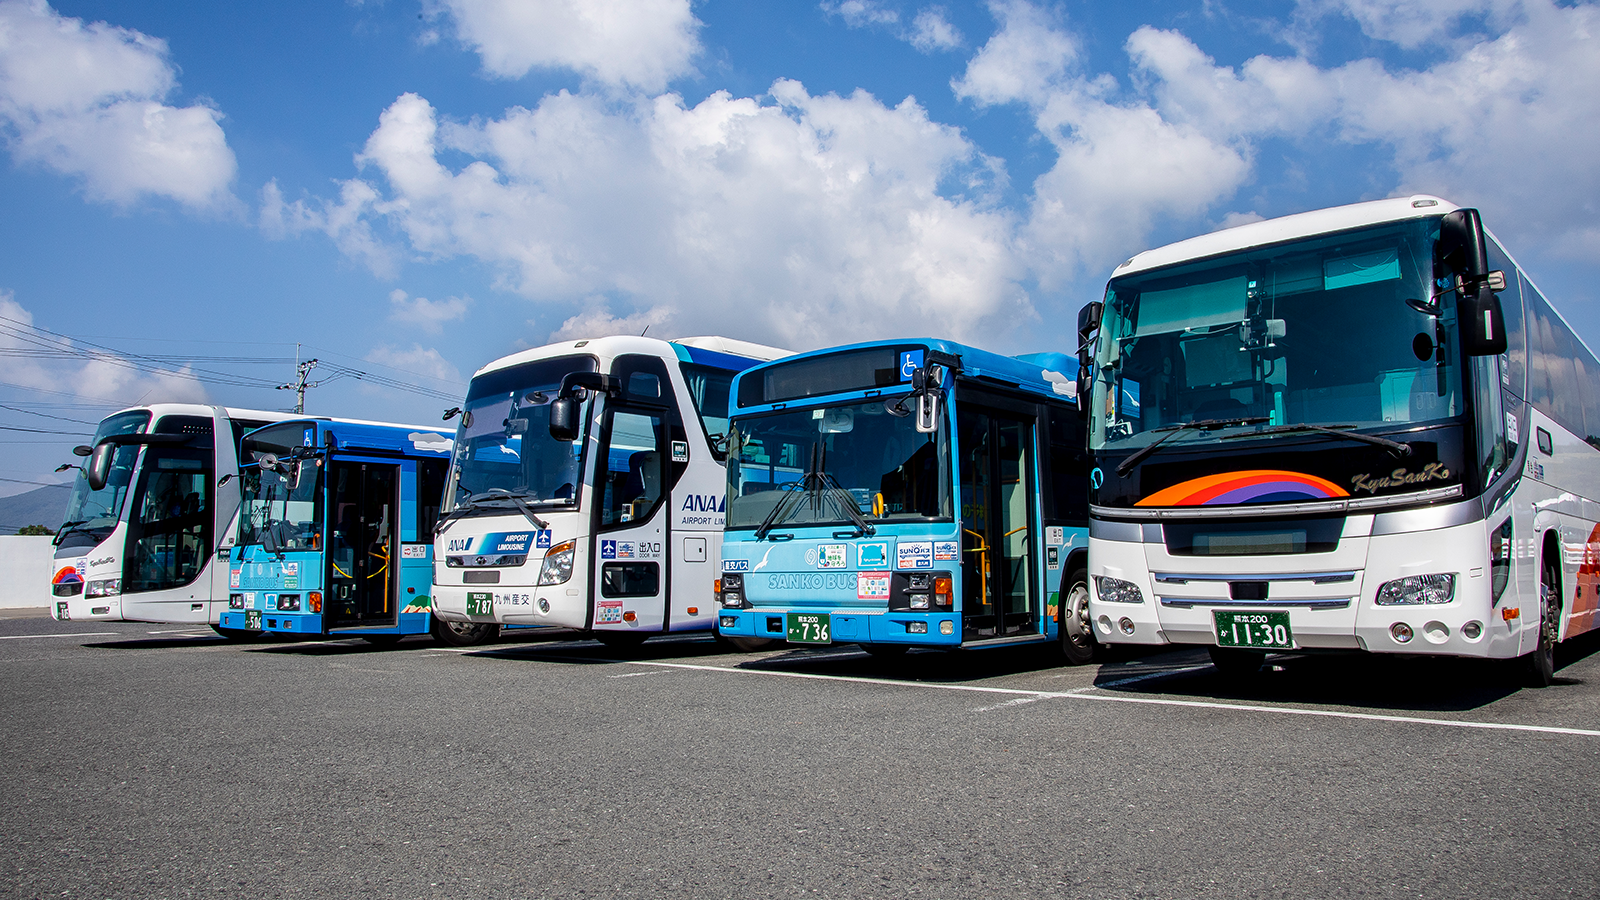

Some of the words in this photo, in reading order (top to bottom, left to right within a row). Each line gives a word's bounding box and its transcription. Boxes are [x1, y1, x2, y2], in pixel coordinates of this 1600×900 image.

[1351, 462, 1450, 494] KyuSanKo
[681, 494, 717, 512] ANA
[681, 516, 712, 525] AIRPORT
[447, 538, 465, 552] ANA
[505, 534, 529, 542] AIRPORT
[497, 543, 525, 551] LIMOUSINE
[639, 542, 661, 553] 出入口
[768, 573, 824, 590] SANKO
[825, 573, 858, 590] BUS
[475, 600, 492, 614] 787
[494, 594, 530, 606] 九州産交
[802, 623, 828, 640] 736
[1231, 623, 1288, 645] 11-30
